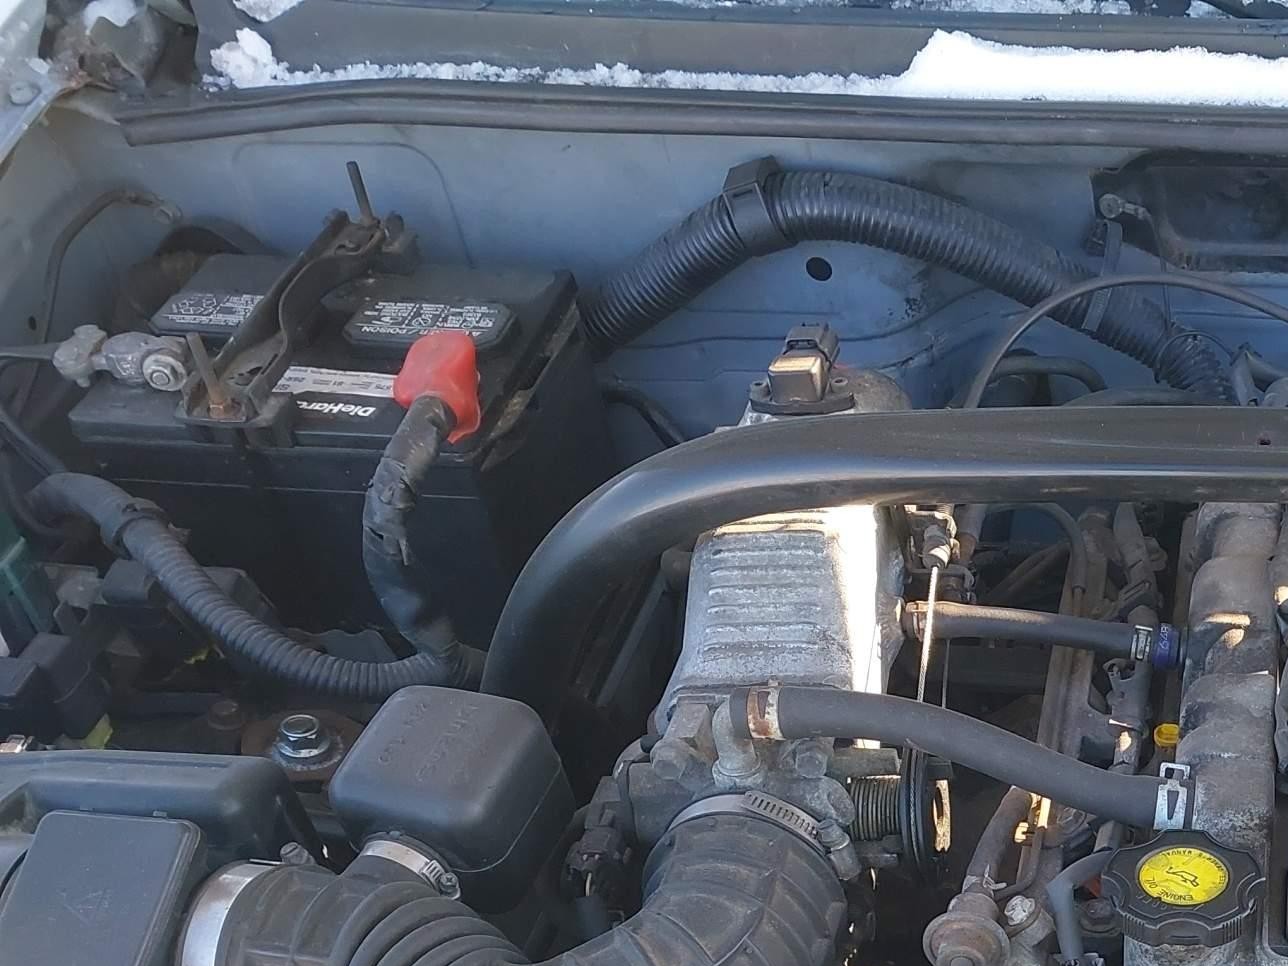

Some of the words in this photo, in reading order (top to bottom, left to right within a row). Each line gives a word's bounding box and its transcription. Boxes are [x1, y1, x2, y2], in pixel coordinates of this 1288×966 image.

[361, 326, 407, 334] POISON
[1143, 877, 1159, 889] OIL
[1157, 888, 1194, 901] ENGINE
